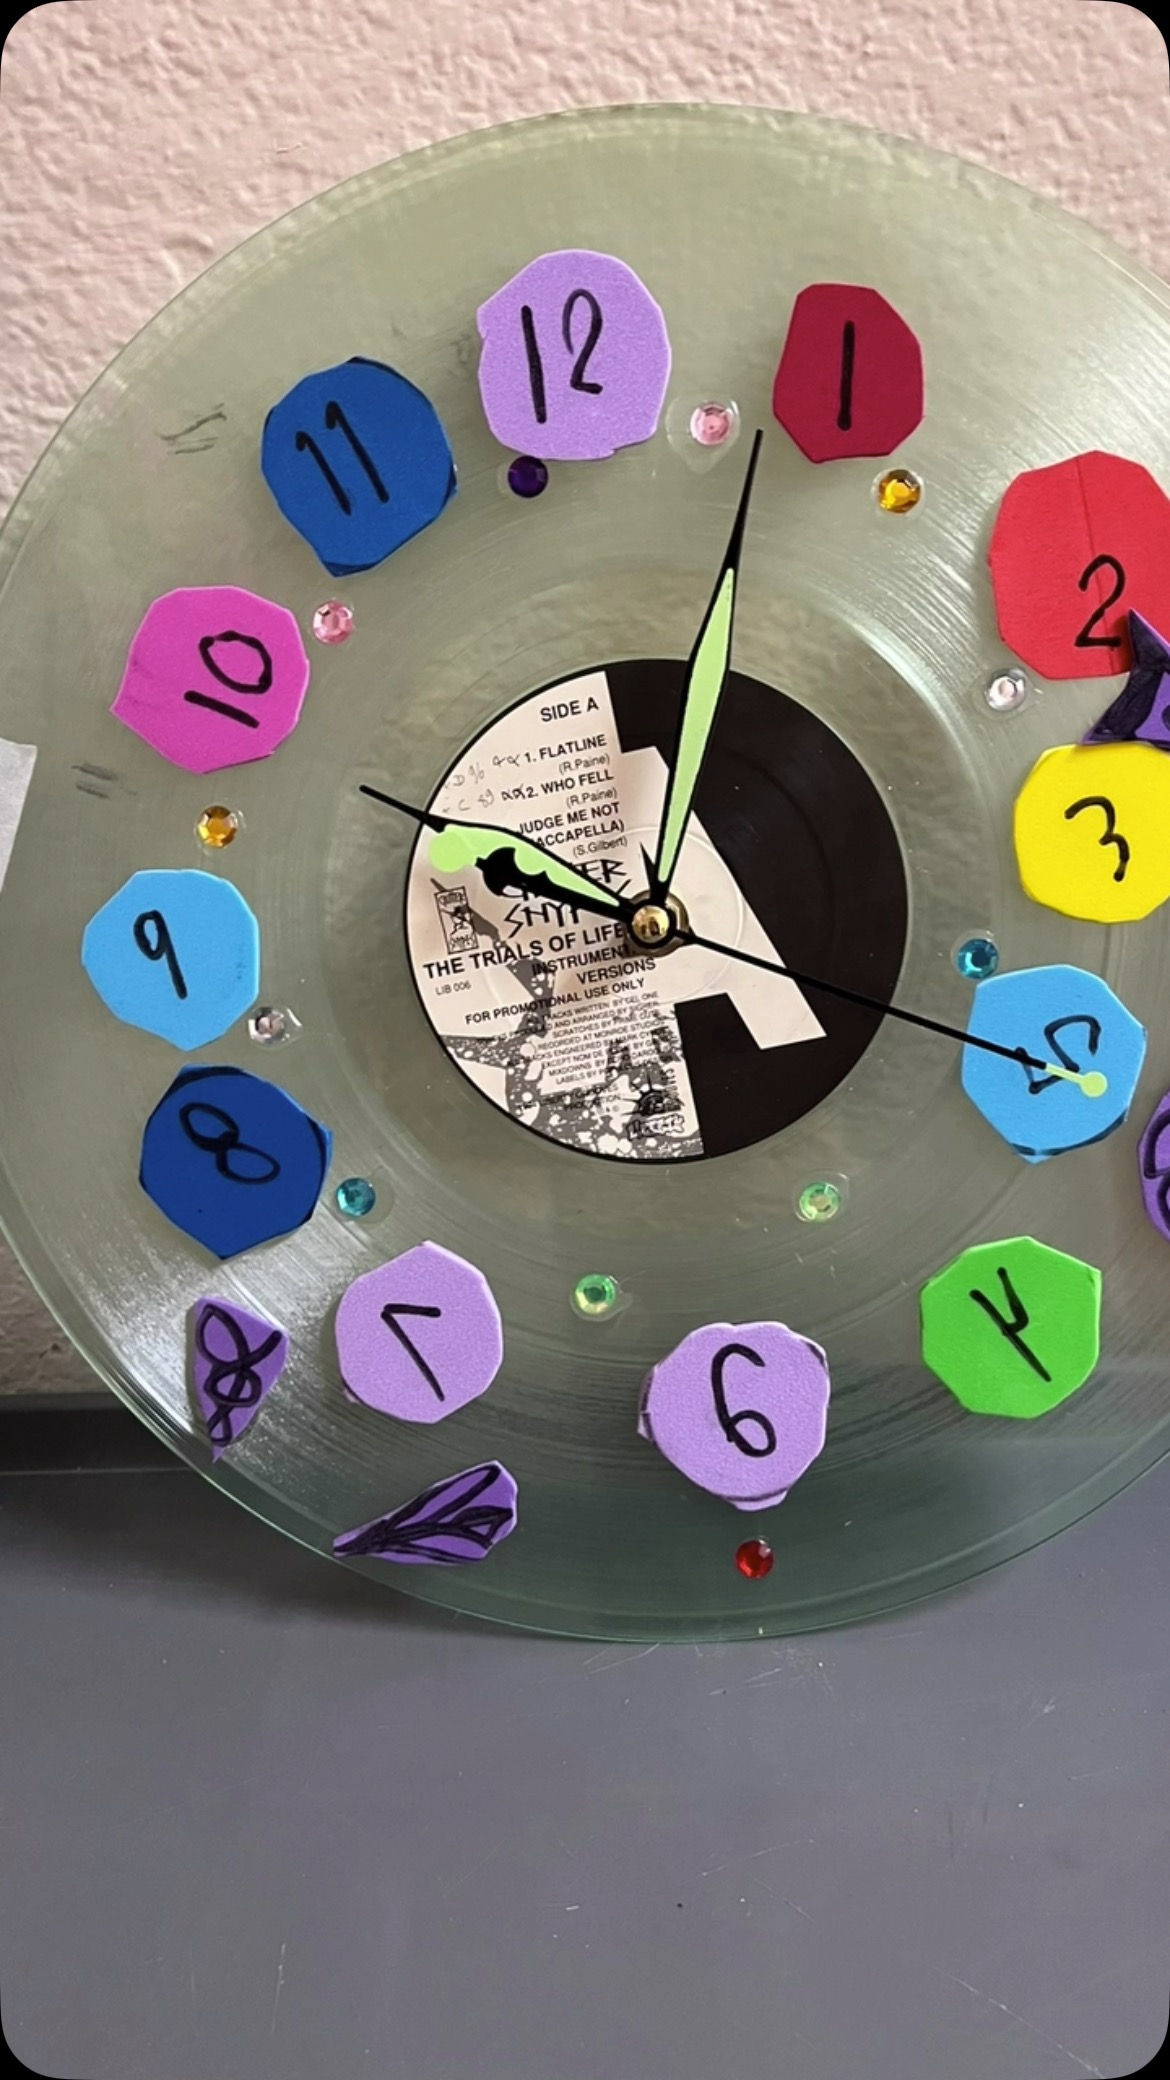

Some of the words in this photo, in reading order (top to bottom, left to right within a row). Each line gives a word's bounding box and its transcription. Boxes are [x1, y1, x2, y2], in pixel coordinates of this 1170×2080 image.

[520, 288, 603, 424] 12
[837, 320, 855, 431] 1
[295, 401, 389, 515] 11
[1074, 553, 1126, 648] 2
[184, 630, 273, 729] 10
[540, 700, 582, 722] SIDE
[586, 696, 599, 712] A
[524, 752, 537, 763] 1.
[539, 734, 607, 760] FLATLINE
[526, 786, 538, 798] 2.
[541, 777, 576, 795] WHO
[578, 769, 615, 787] FELL
[520, 815, 564, 835] JUDGE
[567, 809, 588, 824] ME
[591, 801, 620, 818] NOT
[1064, 795, 1130, 882] 3
[134, 910, 187, 1000] 9
[422, 958, 465, 979] THE
[469, 939, 544, 970] TRIALS
[549, 931, 577, 951] OF
[583, 922, 624, 946] LIFE
[453, 980, 472, 993] 006
[577, 957, 656, 985] VERSIONS
[465, 1008, 491, 1026] FOR
[493, 992, 583, 1020] PROMOTIONAL
[584, 984, 610, 999] USE
[612, 977, 646, 994] ONLY
[583, 1033, 592, 1041] AT
[1015, 1014, 1102, 1095] 5
[180, 1102, 280, 1184] 8
[711, 1343, 776, 1458] 6
